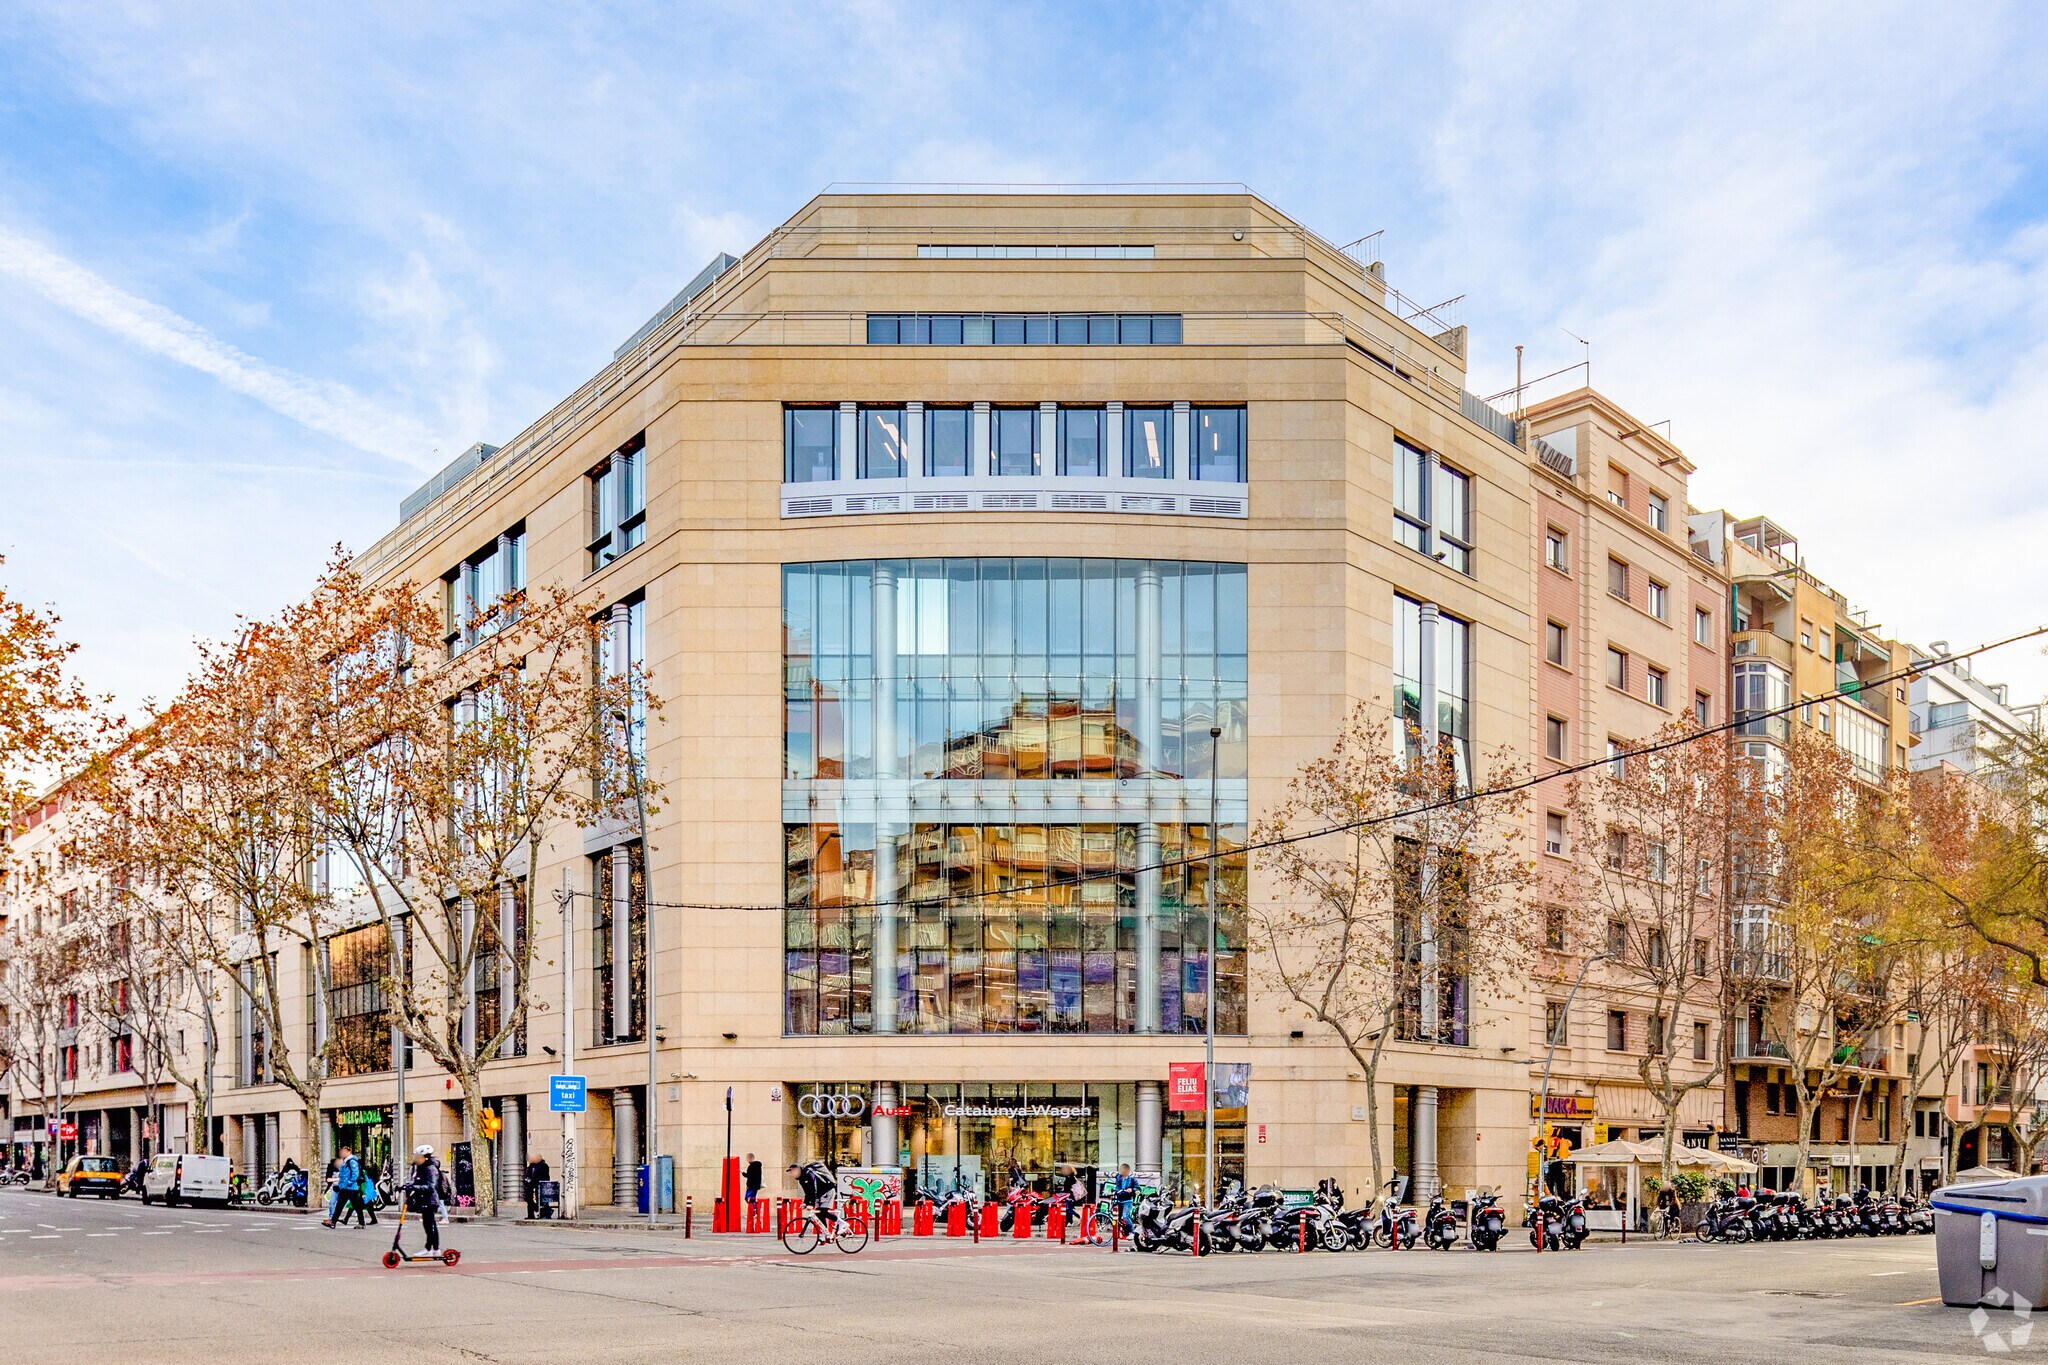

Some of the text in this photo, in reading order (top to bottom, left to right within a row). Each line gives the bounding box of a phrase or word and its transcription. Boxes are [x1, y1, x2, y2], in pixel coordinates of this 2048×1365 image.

[1177, 1085, 1197, 1093] ELIAS
[561, 1091, 575, 1099] taxi
[873, 1104, 912, 1116] Audi
[944, 1105, 1091, 1118] Catalunya Wagen
